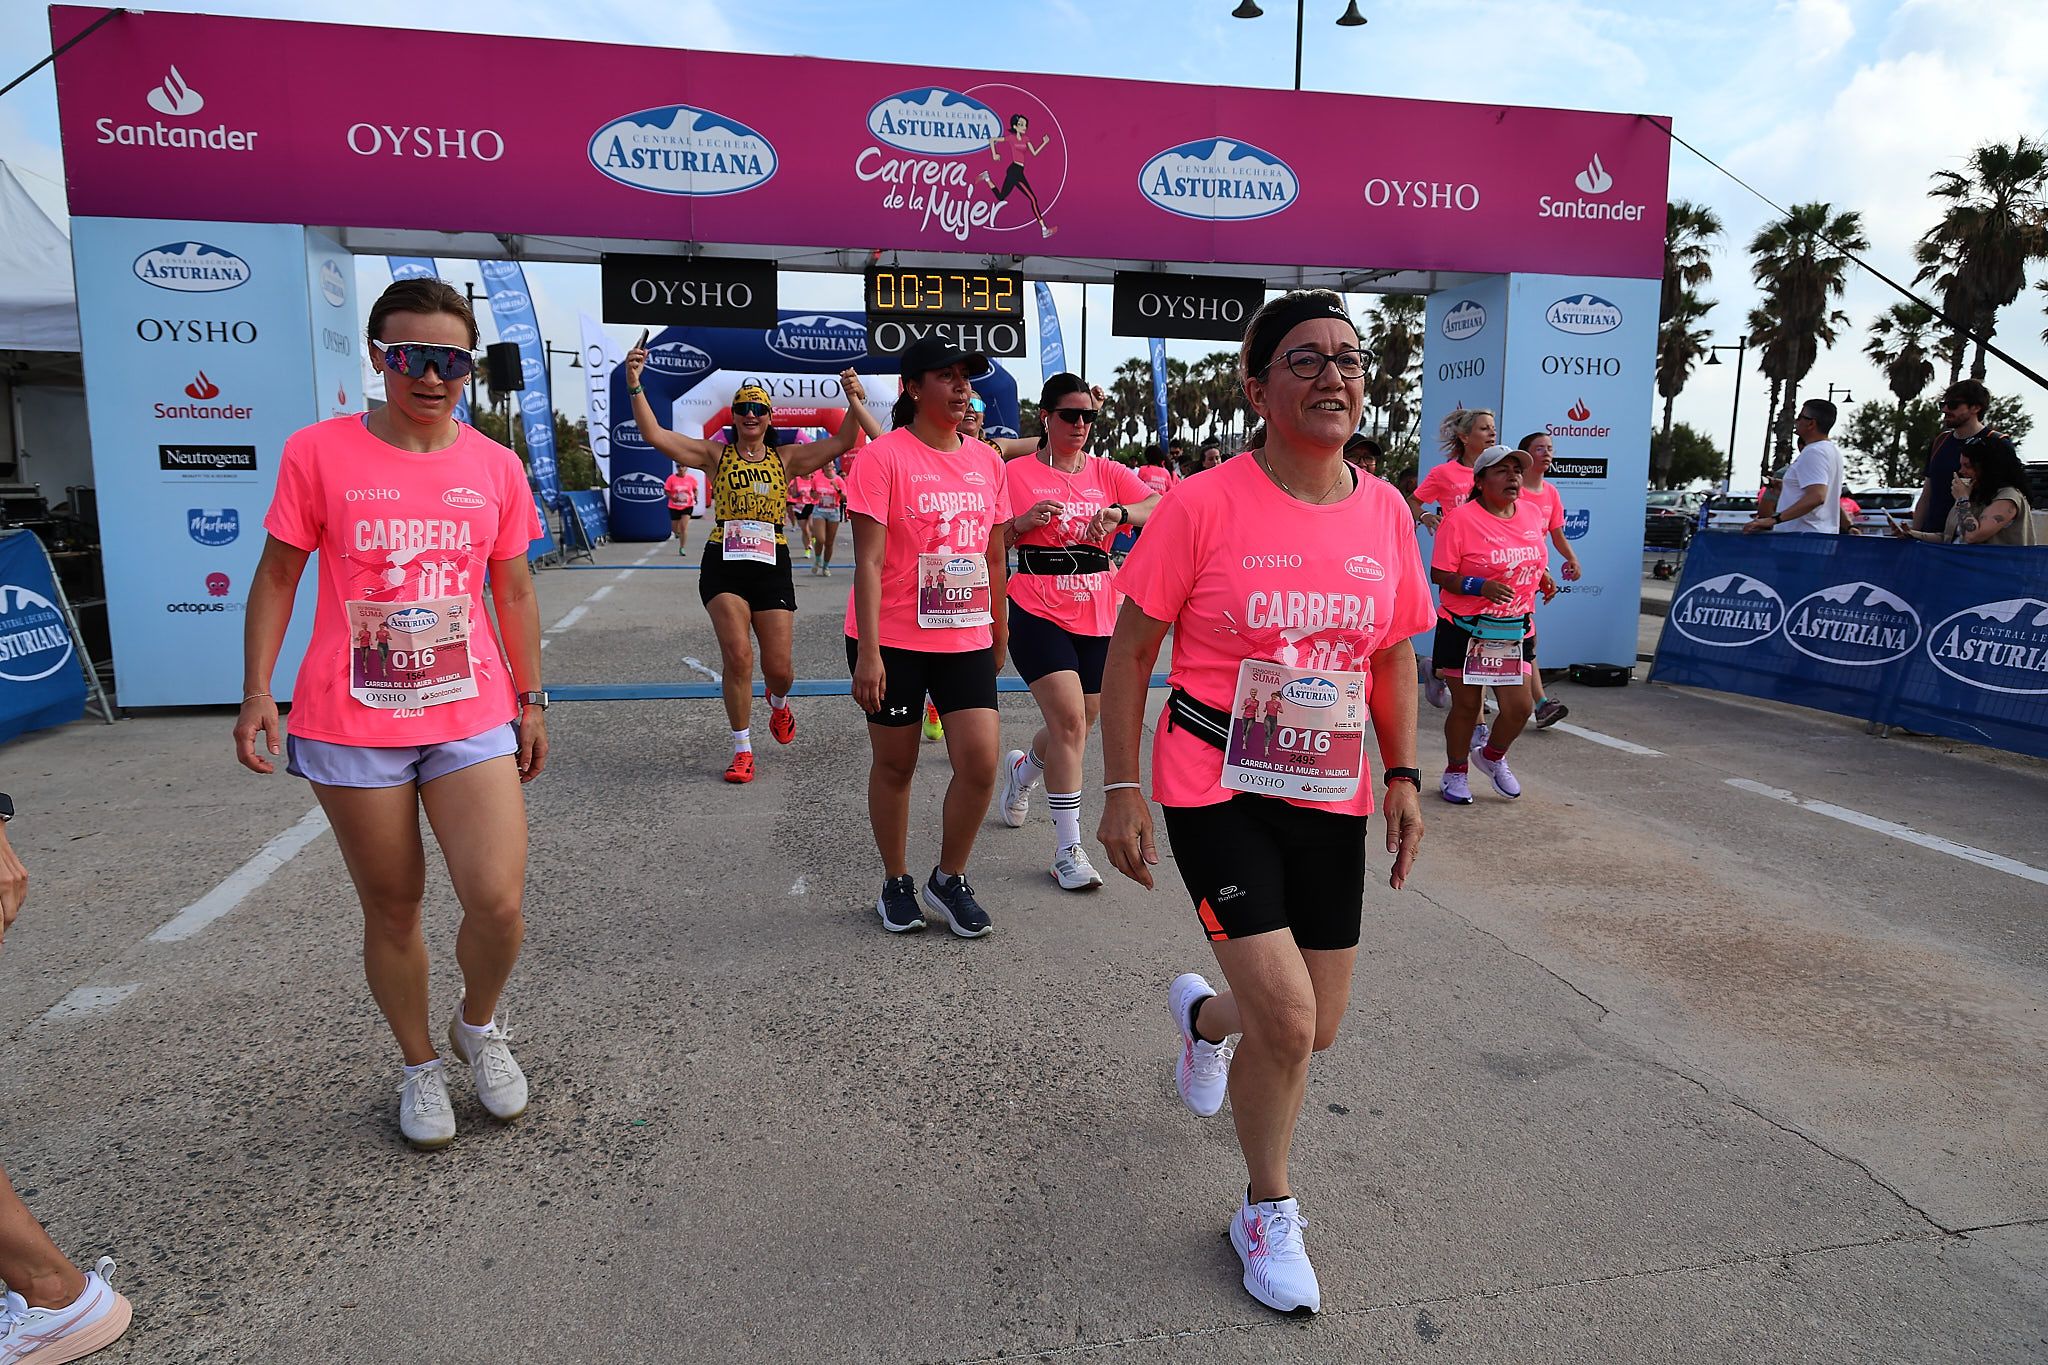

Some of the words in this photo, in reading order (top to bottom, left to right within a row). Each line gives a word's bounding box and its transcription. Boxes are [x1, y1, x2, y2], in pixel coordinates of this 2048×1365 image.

[898, 108, 941, 118] CENTRAL
[945, 111, 989, 121] LECHERA
[877, 109, 992, 140] ASTURIANA
[95, 117, 258, 151] Santander
[346, 123, 505, 161] OYSHO
[632, 134, 691, 146] CENTRAL
[697, 137, 758, 150] LECHERA
[603, 134, 764, 176] ASTURIANA
[854, 146, 967, 187] Carrera
[1176, 164, 1228, 175] CENTRAL
[1231, 167, 1283, 177] LECHERA
[1151, 165, 1287, 201] ASTURIANA
[1363, 178, 1480, 211] OYSHO
[883, 184, 904, 209] de
[908, 184, 924, 210] la
[920, 183, 1009, 242] Mujer
[1538, 196, 1646, 221] Santander
[142, 258, 243, 281] ASTURIANA
[630, 278, 753, 308] OYSHO
[876, 273, 1013, 312] 00:37:32
[1138, 293, 1244, 323] OYSHO
[1551, 308, 1617, 326] ASTURIANA
[136, 318, 258, 344] OYSHO
[1444, 315, 1483, 333] ASTURIANA
[774, 327, 868, 352] ASTURIANA
[1438, 357, 1485, 382] OYSHO
[1541, 355, 1621, 377] OYSHO
[154, 402, 253, 420] Santander
[771, 407, 817, 416] Santander
[1545, 423, 1611, 438] Santander
[166, 449, 250, 468] Neutrogena
[1549, 461, 1603, 475] Neutrogena
[728, 468, 772, 490] COMO
[910, 473, 941, 482] OYSHO
[345, 489, 401, 502] OYSHO
[445, 494, 484, 505] ASTURIANA
[728, 491, 777, 516] CABRA
[918, 491, 986, 514] CARRERA
[355, 519, 472, 552] CARRERA
[740, 536, 761, 545] 016
[1242, 554, 1303, 570] OYSHO
[1491, 546, 1542, 565] CARRERA
[1347, 562, 1384, 577] ASTURIANA
[1056, 573, 1102, 591] MUJER
[945, 588, 973, 601] 016
[166, 602, 224, 615] octopus
[359, 610, 384, 618] SUMA
[1246, 590, 1376, 632] CARRERA
[1677, 596, 1772, 632] ASTURIANA
[1816, 606, 1860, 619] CENTRAL
[391, 617, 435, 628] ASTURIANA
[1789, 606, 1907, 651] ASTURIANA
[1970, 625, 2026, 640] CENTRAL
[391, 648, 436, 670] 016
[1481, 657, 1503, 667] 016
[364, 681, 393, 689] CARRERA
[394, 681, 403, 689] DE
[403, 681, 413, 689] LA
[413, 680, 433, 689] MUJER
[436, 673, 461, 684] VALENCIA
[405, 671, 426, 681] 1564
[1252, 673, 1281, 686] SUMA
[366, 693, 407, 703] OYSHO
[430, 687, 463, 699] Santander
[1286, 686, 1336, 702] ASTURIANA
[1278, 727, 1331, 753] 016
[1240, 758, 1273, 771] CARRERA
[1274, 763, 1285, 772] DE
[1285, 765, 1295, 773] LA
[1295, 766, 1319, 776] MUJER
[1324, 768, 1350, 777] VALENCIA
[1289, 753, 1316, 766] 2495
[1238, 773, 1285, 789] OYSHO
[1312, 784, 1348, 795] Santander
